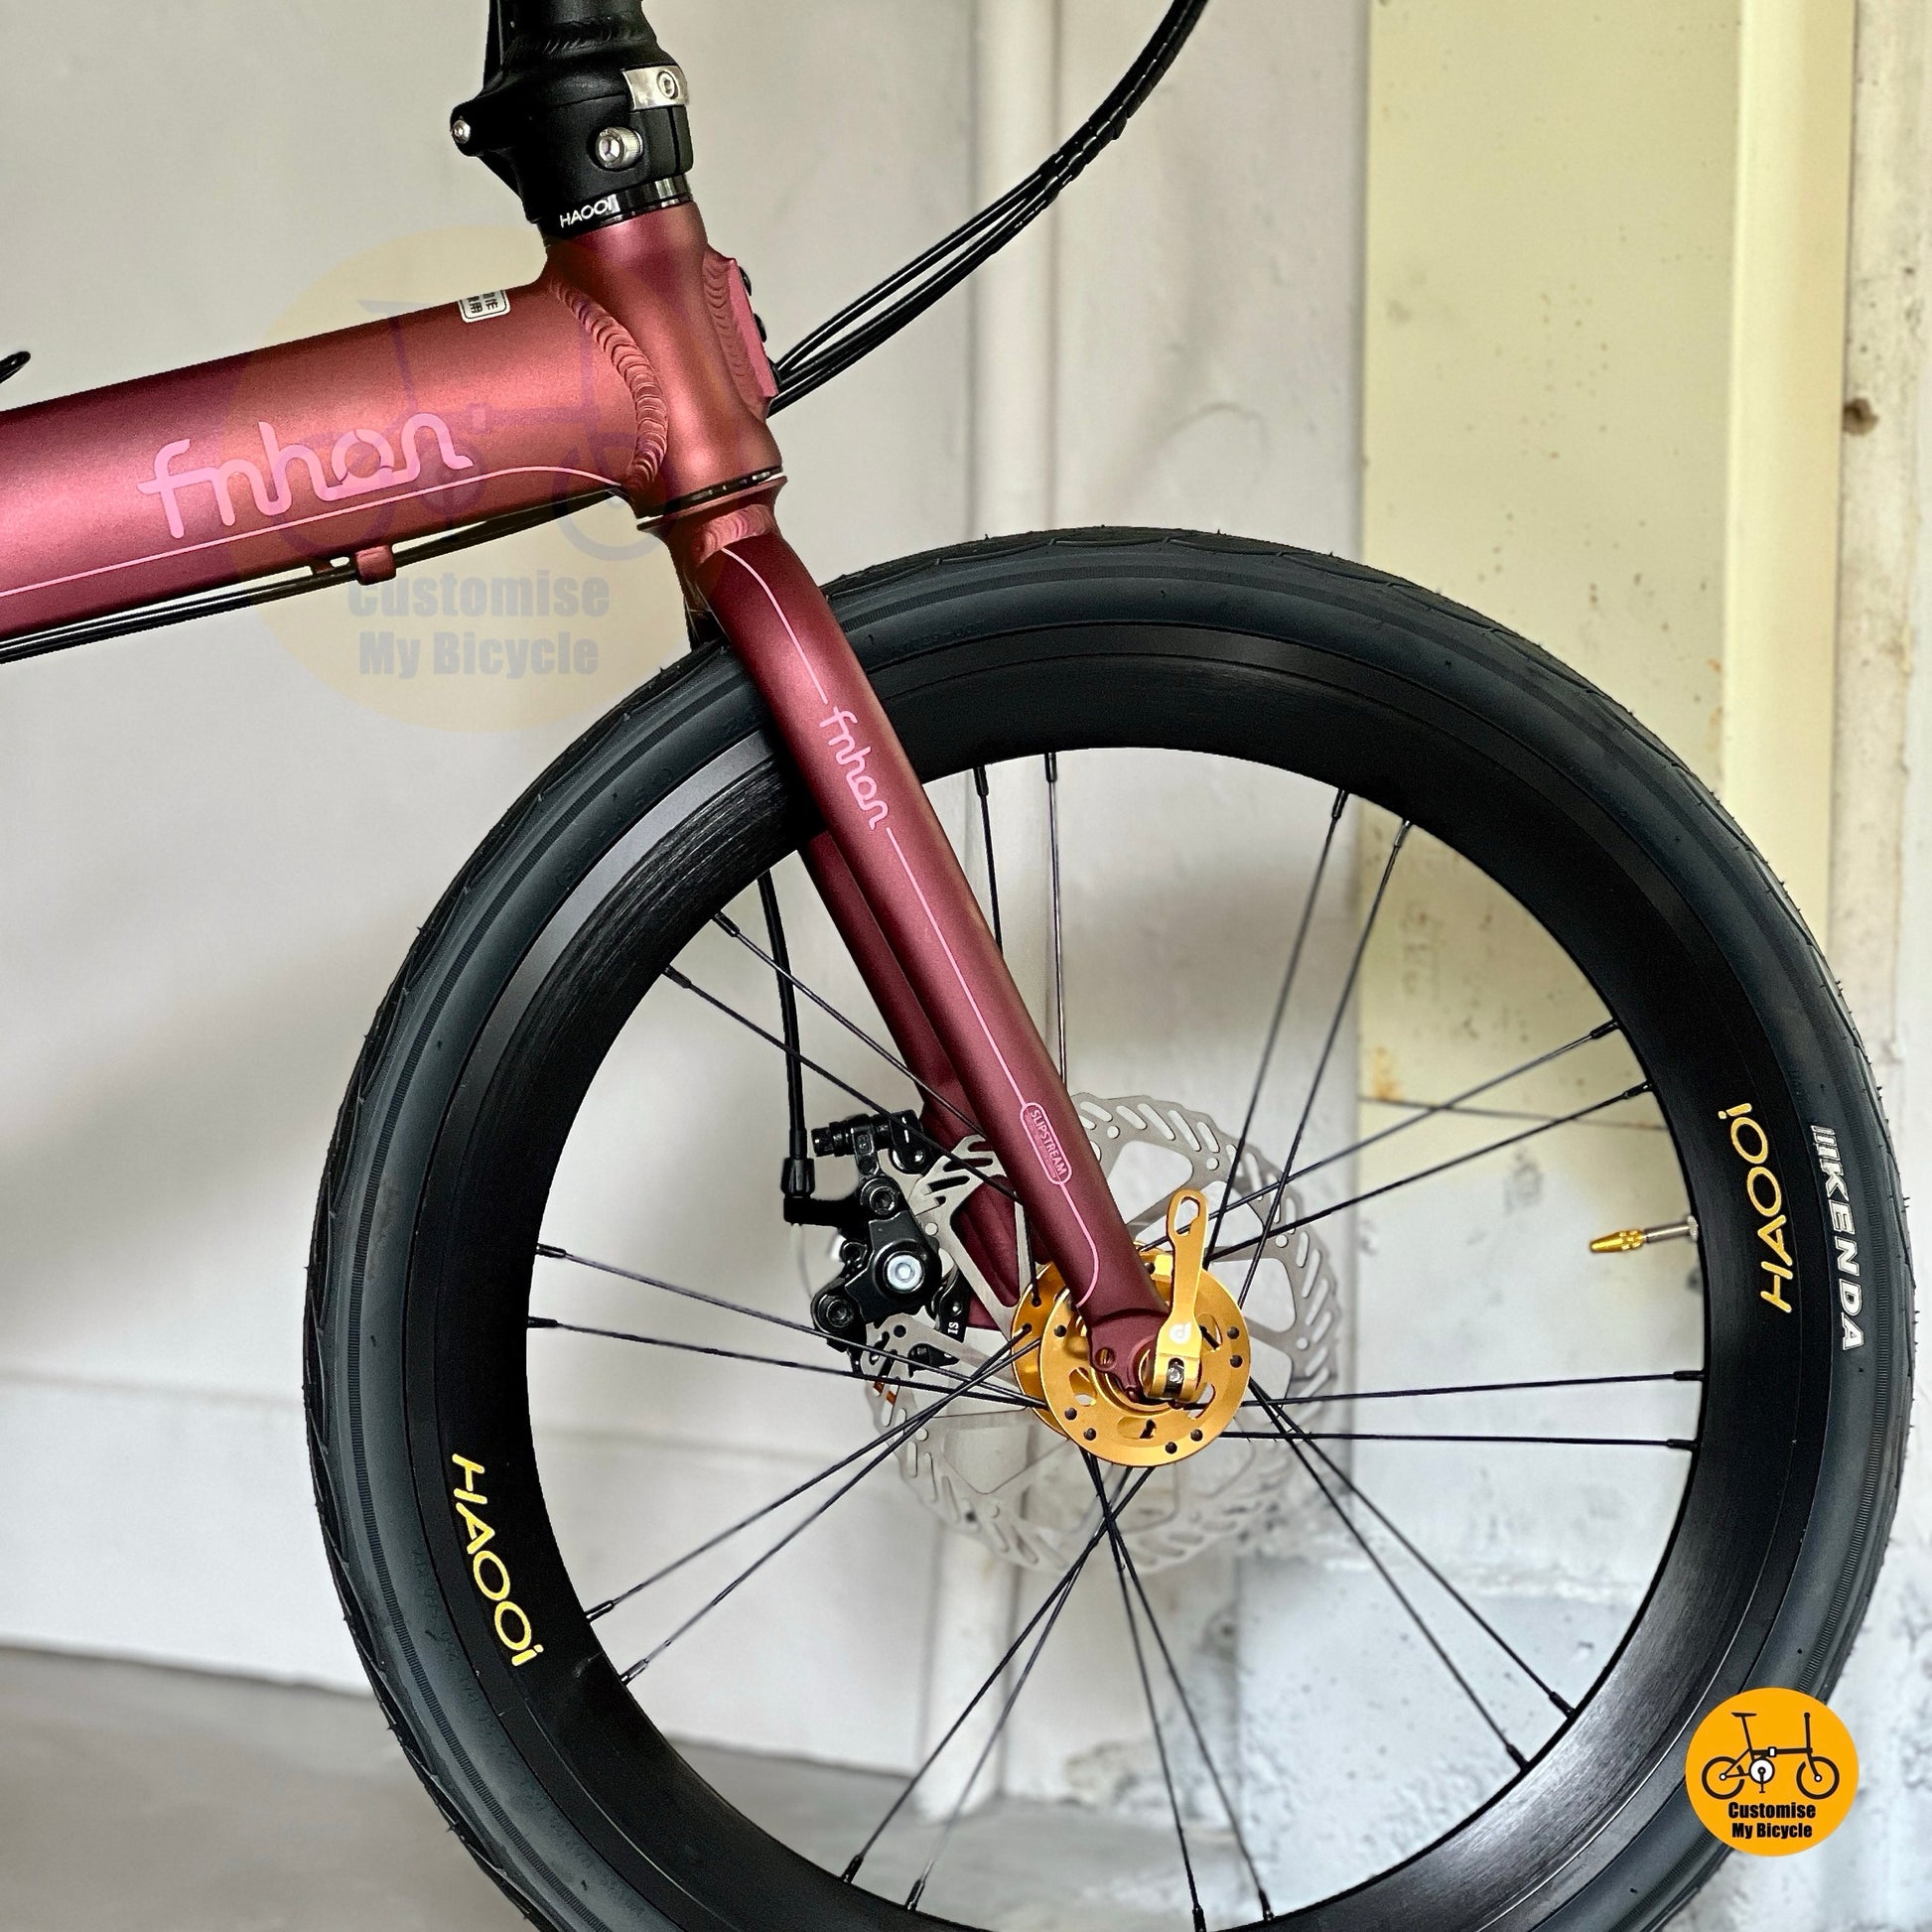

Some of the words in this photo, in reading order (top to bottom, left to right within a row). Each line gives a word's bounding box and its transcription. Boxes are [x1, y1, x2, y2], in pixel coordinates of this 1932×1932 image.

[137, 413, 474, 539] fnhon
[819, 706, 888, 830] fnhon
[1032, 1109, 1067, 1175] SLIPSTREAM
[1821, 1152, 1864, 1351] KENDA
